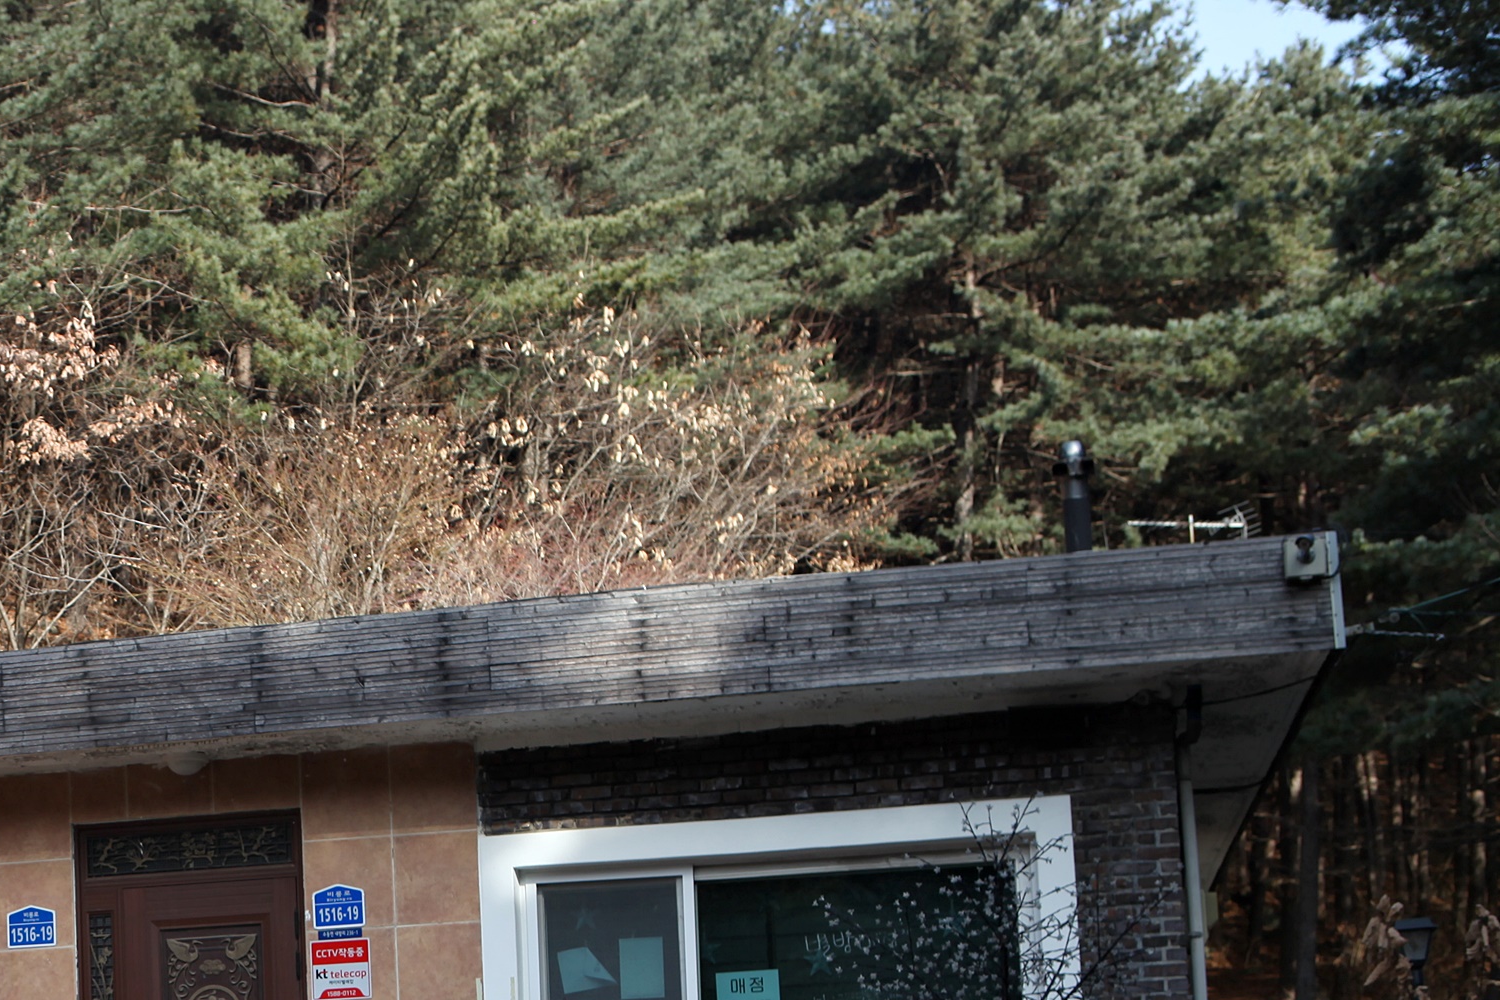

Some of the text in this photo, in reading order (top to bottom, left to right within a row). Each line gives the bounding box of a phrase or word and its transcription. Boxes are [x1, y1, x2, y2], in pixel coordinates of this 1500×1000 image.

[319, 906, 359, 922] 1516-19
[11, 926, 53, 943] 1516-19
[316, 947, 364, 958] CCTV작동중
[316, 969, 366, 979] kt telecop
[730, 977, 764, 994] 매점
